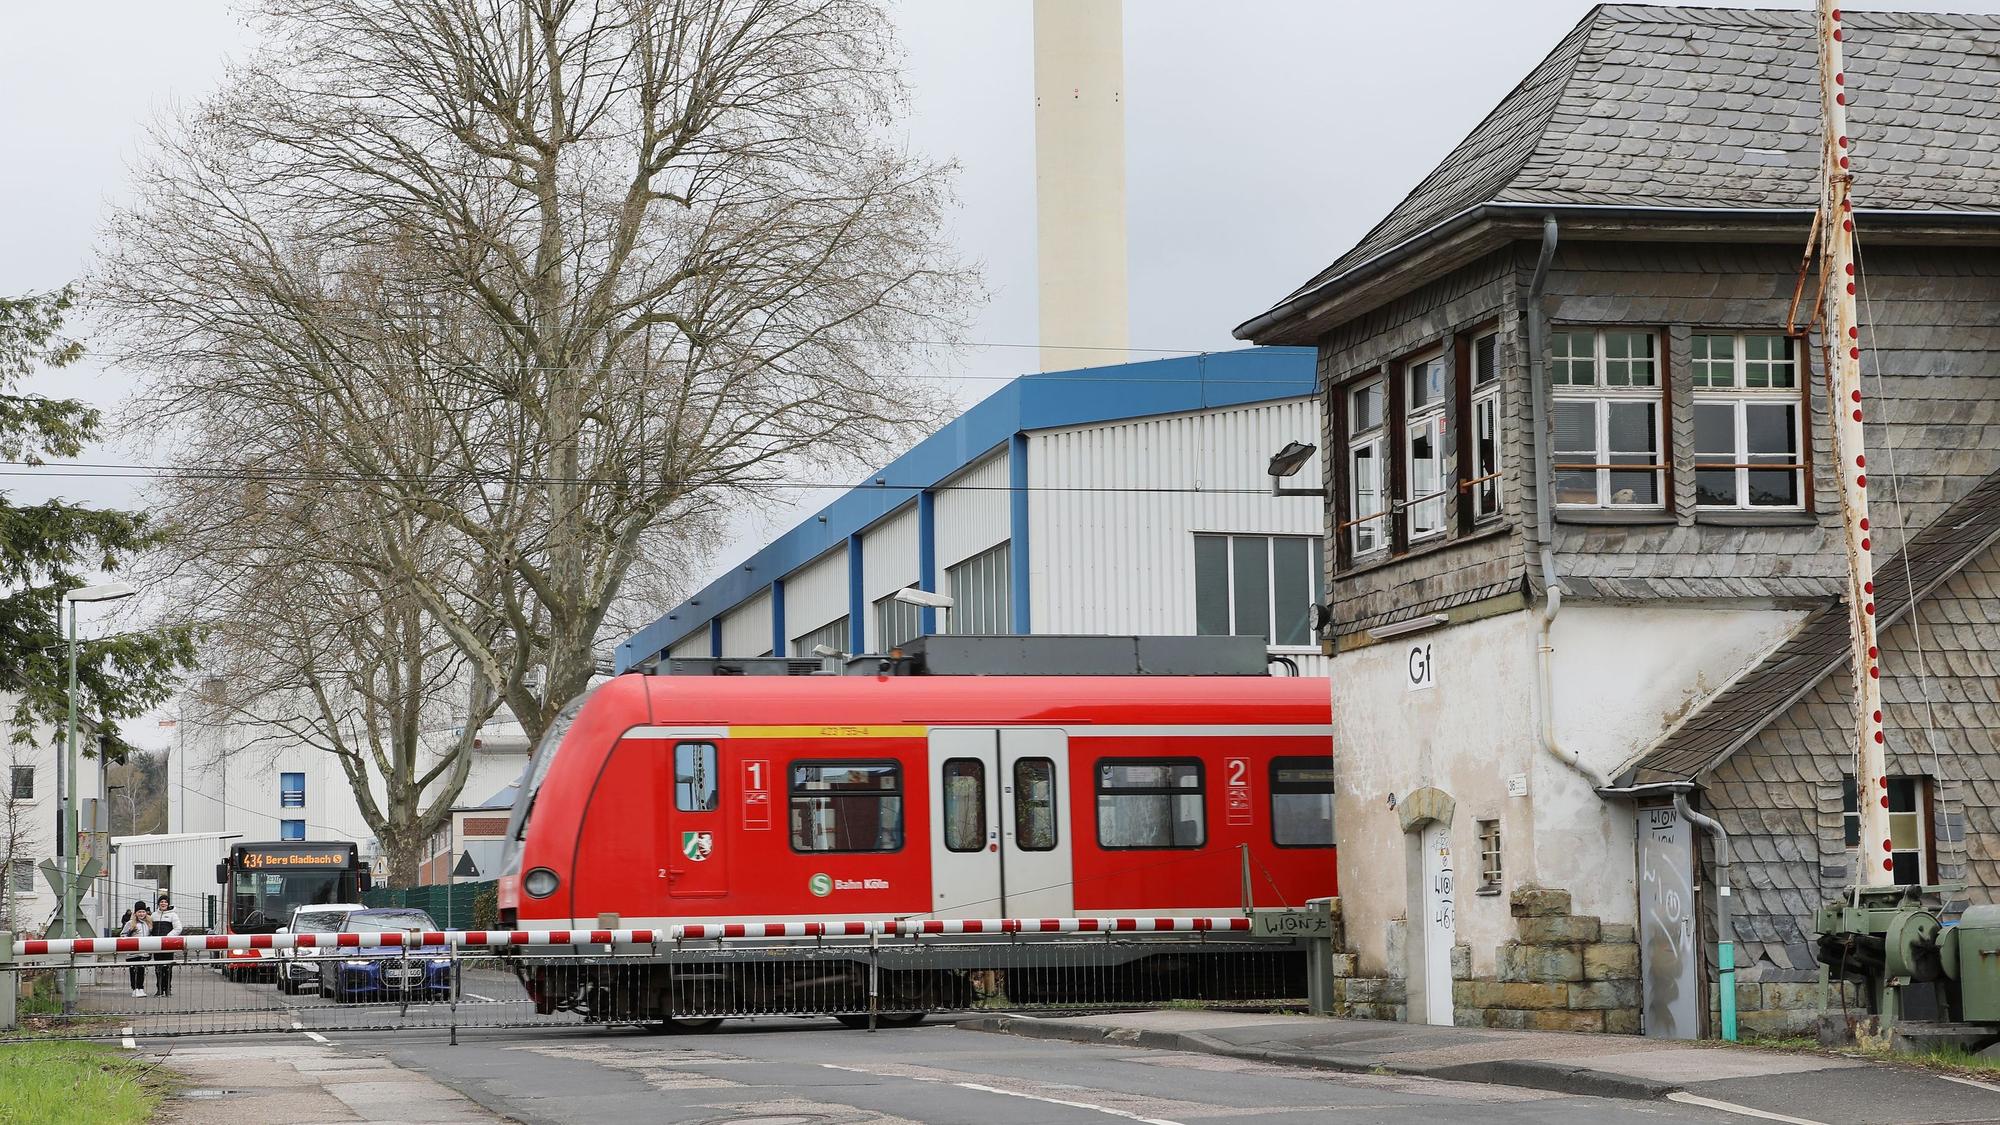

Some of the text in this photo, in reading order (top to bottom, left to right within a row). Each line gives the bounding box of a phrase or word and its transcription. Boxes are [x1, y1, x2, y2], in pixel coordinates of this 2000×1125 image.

[1409, 643, 1431, 684] Gf
[747, 762, 761, 789] 1
[1228, 760, 1246, 786] 2
[243, 854, 263, 868] 434
[265, 855, 288, 865] Berg
[289, 854, 331, 864] Gladbach
[658, 868, 666, 877] 2
[811, 874, 889, 895] S Bahn Köln
